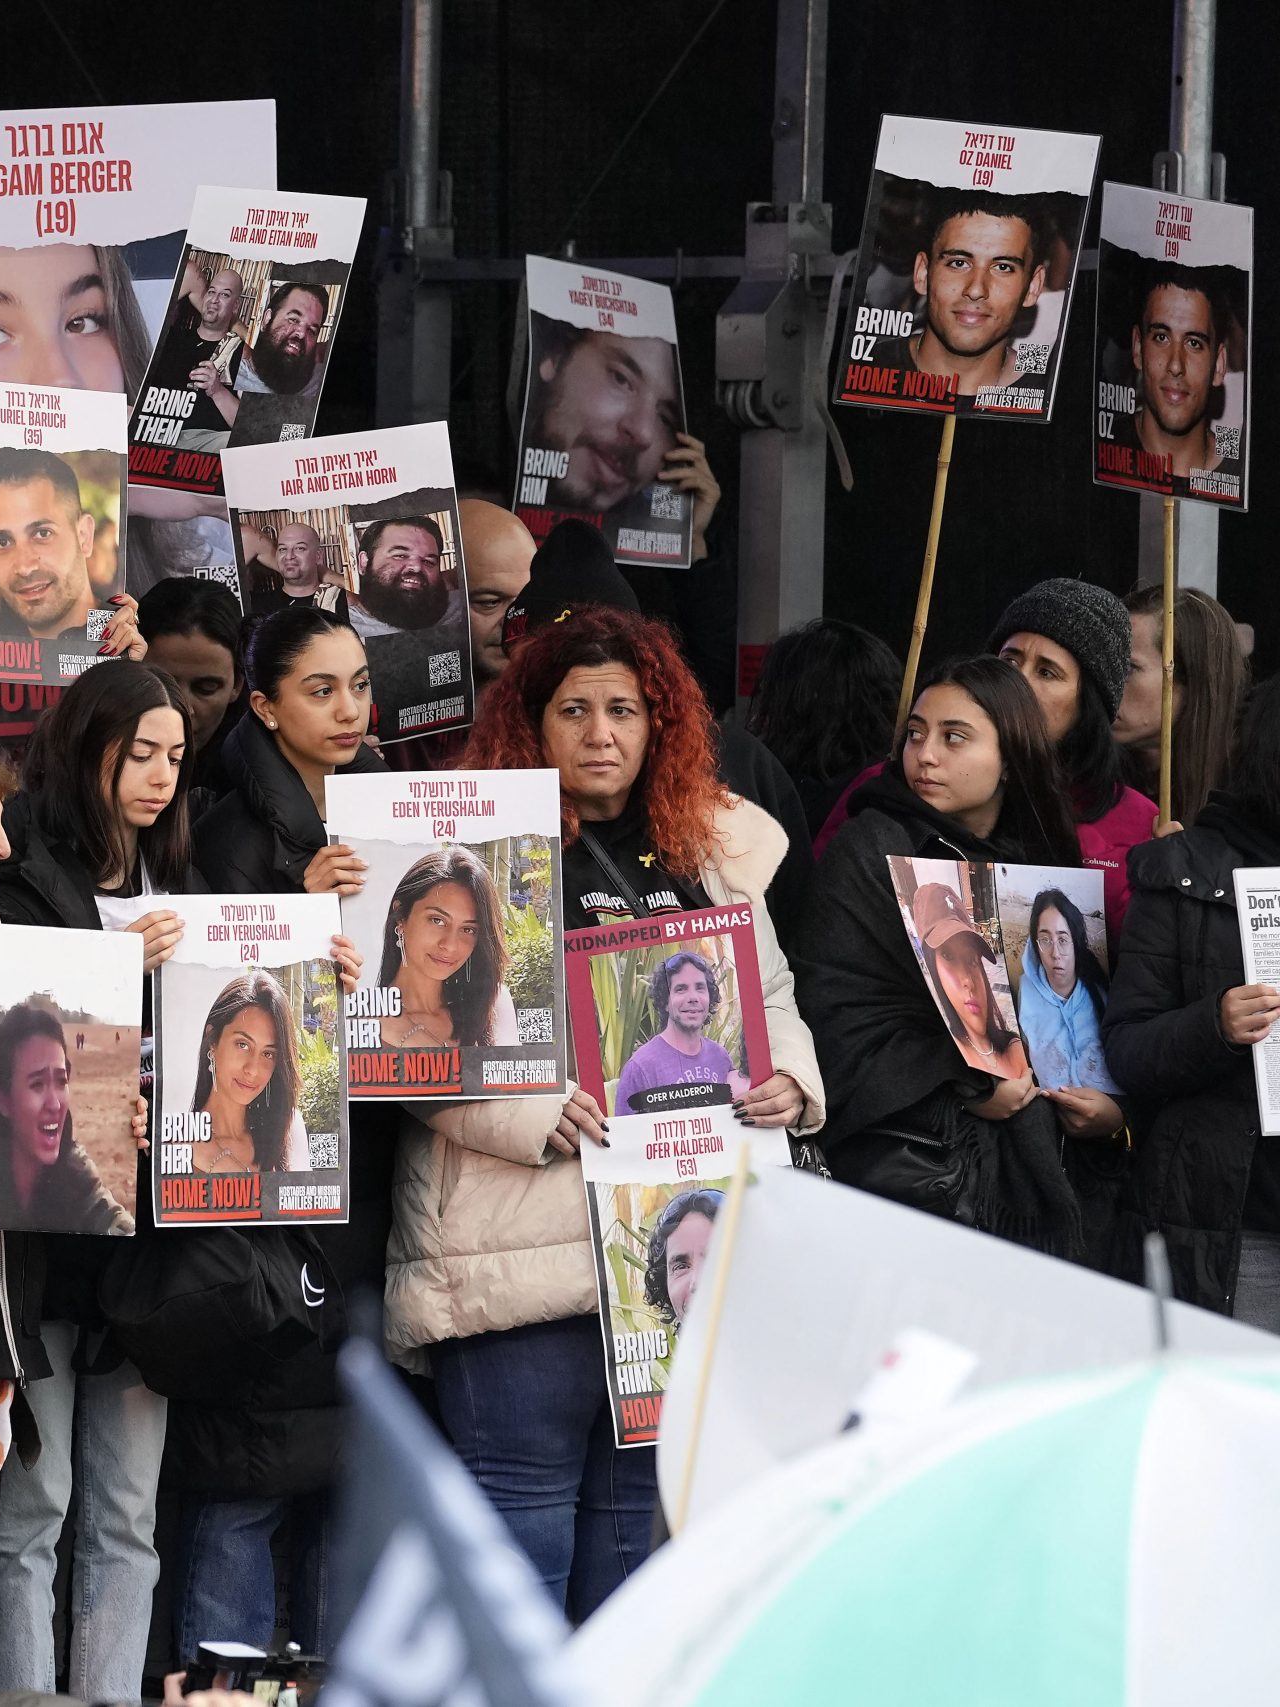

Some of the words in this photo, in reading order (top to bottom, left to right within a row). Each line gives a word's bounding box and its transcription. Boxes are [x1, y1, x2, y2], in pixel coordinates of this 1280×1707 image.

[5, 125, 55, 157] ברגר
[62, 123, 105, 155] אגם
[964, 132, 995, 151] דניאל
[997, 135, 1015, 152] עוז
[960, 150, 974, 166] OZ
[975, 151, 1012, 170] DANIEL
[50, 159, 133, 195] BERGER
[972, 170, 993, 187] (19)
[35, 200, 77, 237] (19)
[246, 208, 264, 226] הורן
[265, 210, 289, 228] ואיתן
[291, 212, 309, 229] יאיר
[1158, 201, 1180, 221] דניאל
[1180, 206, 1193, 223] עוז
[229, 226, 248, 243] IAIR
[248, 228, 268, 245] AND
[268, 229, 294, 247] EITAN
[293, 231, 318, 249] HORN
[1155, 220, 1166, 237] OZ
[1166, 222, 1192, 242] DANIEL
[1165, 240, 1179, 258] (19)
[855, 306, 914, 338] BRING
[850, 335, 877, 362] OZ
[845, 364, 900, 395] HOME
[903, 372, 960, 402] NOW!
[977, 385, 1007, 395] HOSTAGES
[1006, 387, 1018, 396] AND
[1019, 387, 1045, 398] MISSING
[5, 391, 26, 410] ברוך
[28, 392, 61, 411] אוריאל
[141, 386, 197, 419] BRING
[975, 394, 1012, 408] FAMILIES
[1013, 397, 1043, 410] FORUM
[1098, 381, 1136, 414] BRING
[0, 409, 26, 427] URIEL
[28, 410, 66, 429] BARUCH
[1098, 411, 1115, 440] OZ
[23, 428, 43, 446] (35)
[133, 415, 184, 446] THEM
[128, 446, 174, 475] HOME
[173, 451, 222, 483] NOW!
[295, 457, 319, 477] הורן
[320, 453, 351, 472] ואיתן
[354, 450, 378, 468] יאיר
[524, 448, 570, 480] BRING
[1097, 442, 1133, 474] HOME
[1136, 451, 1173, 483] NOW!
[281, 475, 305, 496] IAIR
[307, 473, 329, 494] AND
[332, 470, 364, 491] EITAN
[366, 466, 397, 486] HORN
[1190, 477, 1217, 494] FAMILIES
[1218, 481, 1240, 498] FORUM
[520, 477, 549, 506] HIM
[58, 654, 85, 664] HOSTAGES
[86, 655, 97, 664] AND
[399, 703, 427, 717] HOSTAGES
[427, 700, 439, 711] AND
[440, 695, 465, 707] MISSING
[399, 710, 434, 730] FAMILIES
[435, 704, 465, 721] FORUM
[408, 780, 455, 799] ירושלמי
[458, 780, 477, 798] עדן
[392, 800, 422, 818] EDEN
[423, 799, 495, 818] YERUSHALMI
[432, 819, 456, 838] (24)
[1082, 858, 1119, 868] Columbia
[220, 904, 257, 922] ירושלמי
[260, 904, 276, 922] עדן
[1251, 913, 1280, 931] girls
[207, 925, 232, 943] EDEN
[232, 924, 290, 942] YERUSHALMI
[564, 925, 660, 954] KIDNAPPED
[665, 920, 687, 938] BY
[691, 910, 751, 933] HAMAS
[240, 943, 260, 962] (24)
[345, 986, 401, 1018] BRING
[345, 1019, 382, 1049] HER
[348, 1051, 399, 1084] HOME
[403, 1048, 463, 1083] NOW!
[482, 1061, 514, 1071] HOSTAGES
[515, 1060, 528, 1070] AND
[528, 1060, 556, 1070] MISSING
[483, 1070, 523, 1085] FAMILIES
[524, 1070, 557, 1083] FORUM
[646, 1091, 668, 1103] OFER
[668, 1084, 713, 1101] KALDERON
[161, 1112, 212, 1143] BRING
[653, 1119, 685, 1141] קלדרון
[689, 1117, 712, 1136] עופר
[646, 1141, 671, 1160] OFER
[673, 1135, 724, 1158] KALDERON
[161, 1144, 193, 1175] HER
[676, 1158, 698, 1177] (53)
[162, 1178, 208, 1210] HOME
[211, 1174, 261, 1209] NOW!
[306, 1186, 317, 1196] AND
[279, 1196, 312, 1210] FAMILIES
[313, 1195, 341, 1210] FORUM
[614, 1328, 669, 1364] BRING
[617, 1363, 653, 1396] HIM
